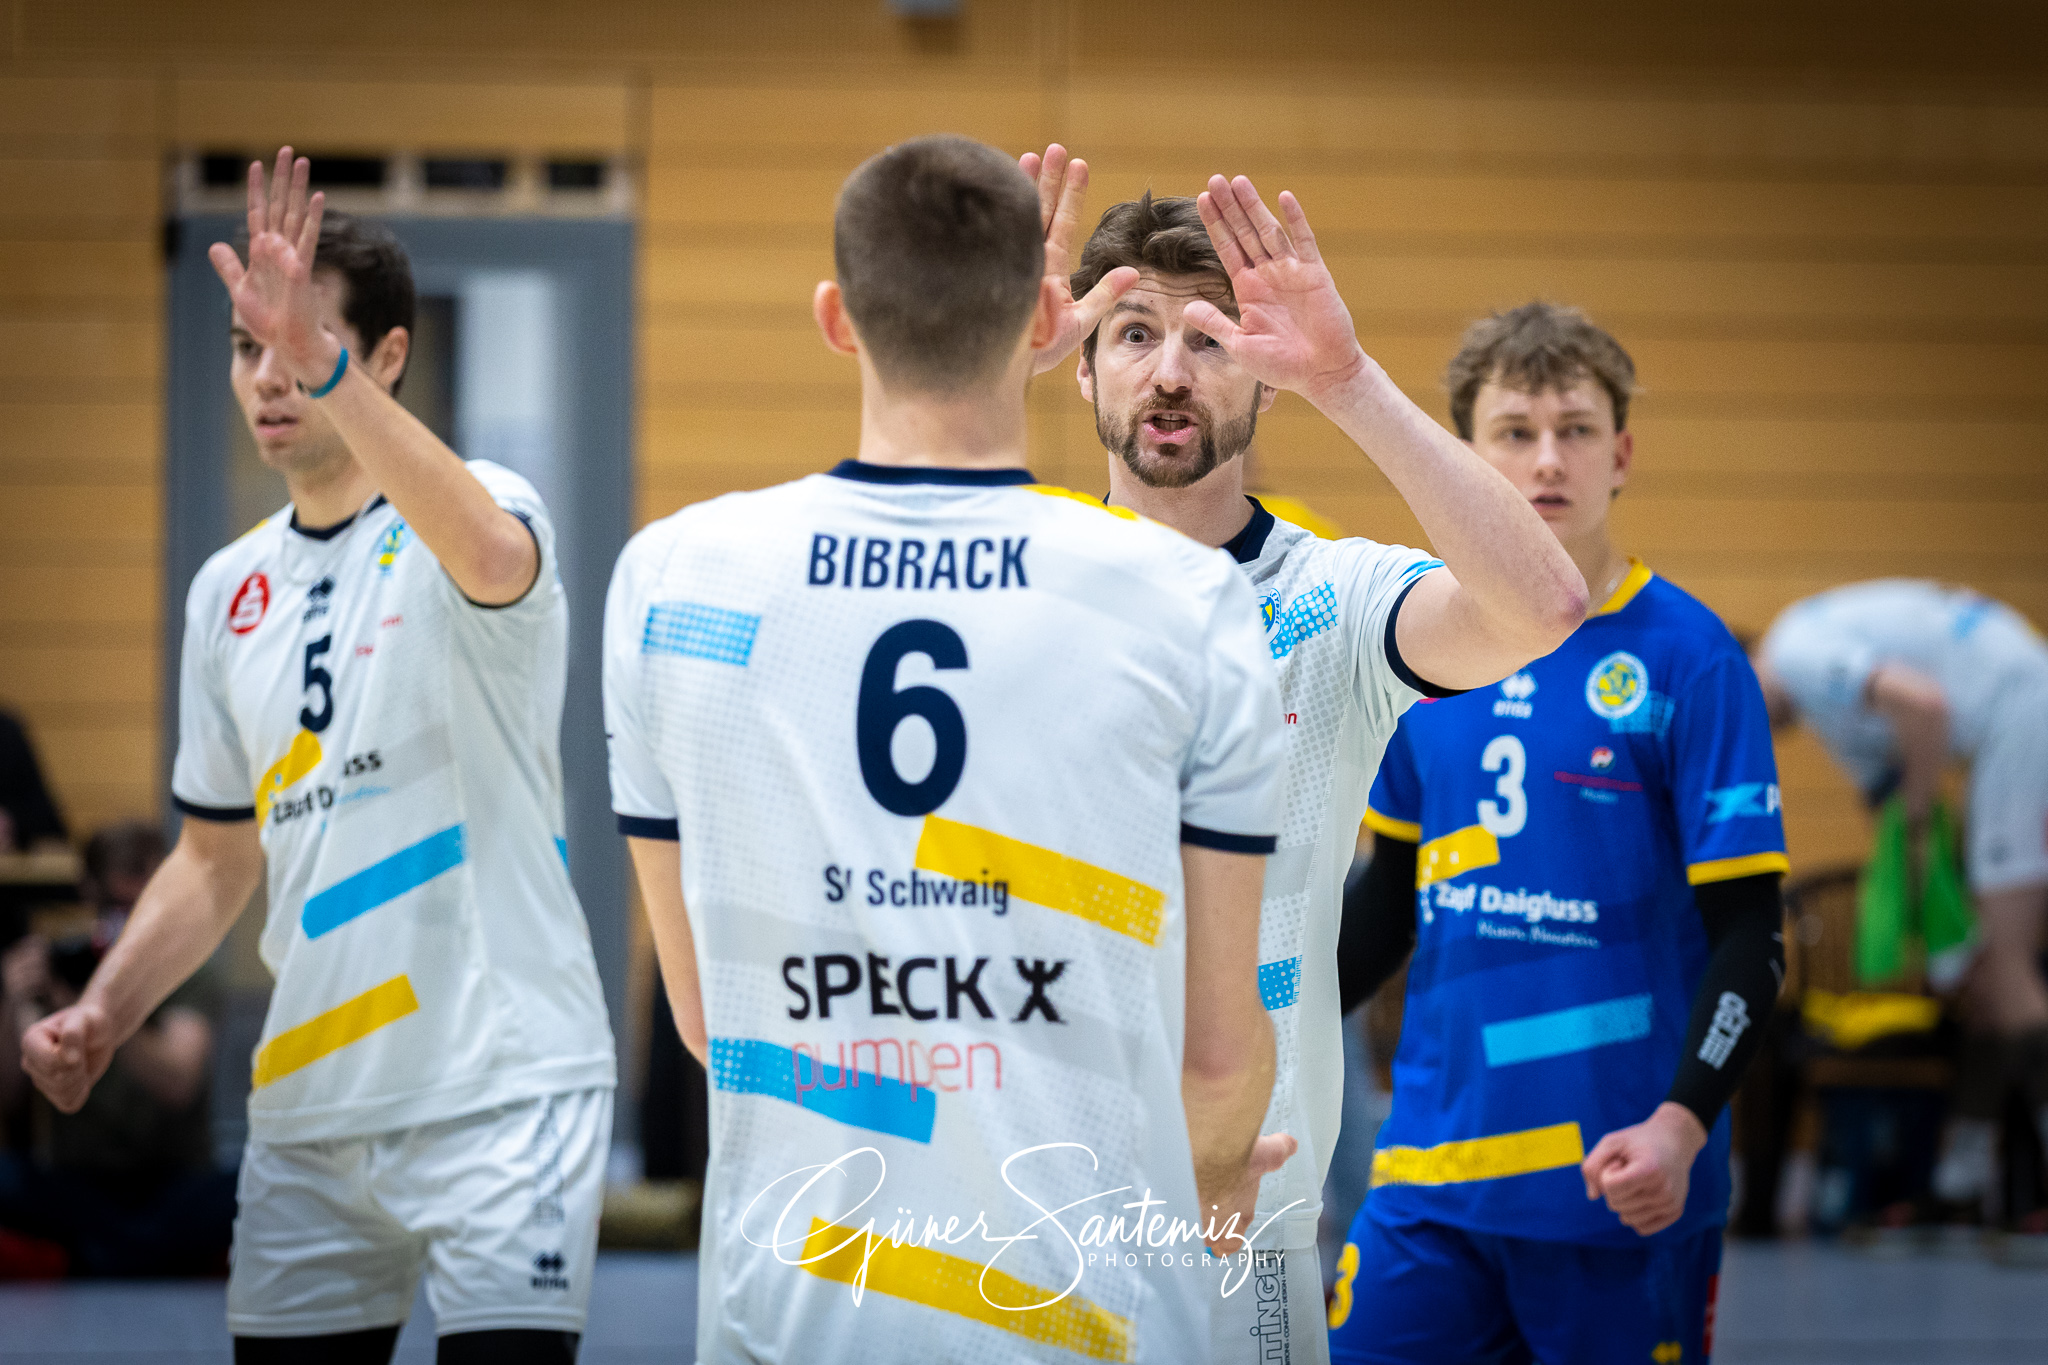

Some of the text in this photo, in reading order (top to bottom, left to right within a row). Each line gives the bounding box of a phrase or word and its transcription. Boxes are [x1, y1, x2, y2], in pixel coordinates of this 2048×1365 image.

[808, 534, 1029, 590] BIBRACK
[300, 634, 333, 733] 5
[856, 618, 969, 817] 6
[1477, 734, 1528, 838] 3
[866, 868, 1009, 917] Schwaig
[781, 951, 996, 1022] SPECK
[791, 1037, 1003, 1106] pumpen
[1328, 1243, 1361, 1330] 3
